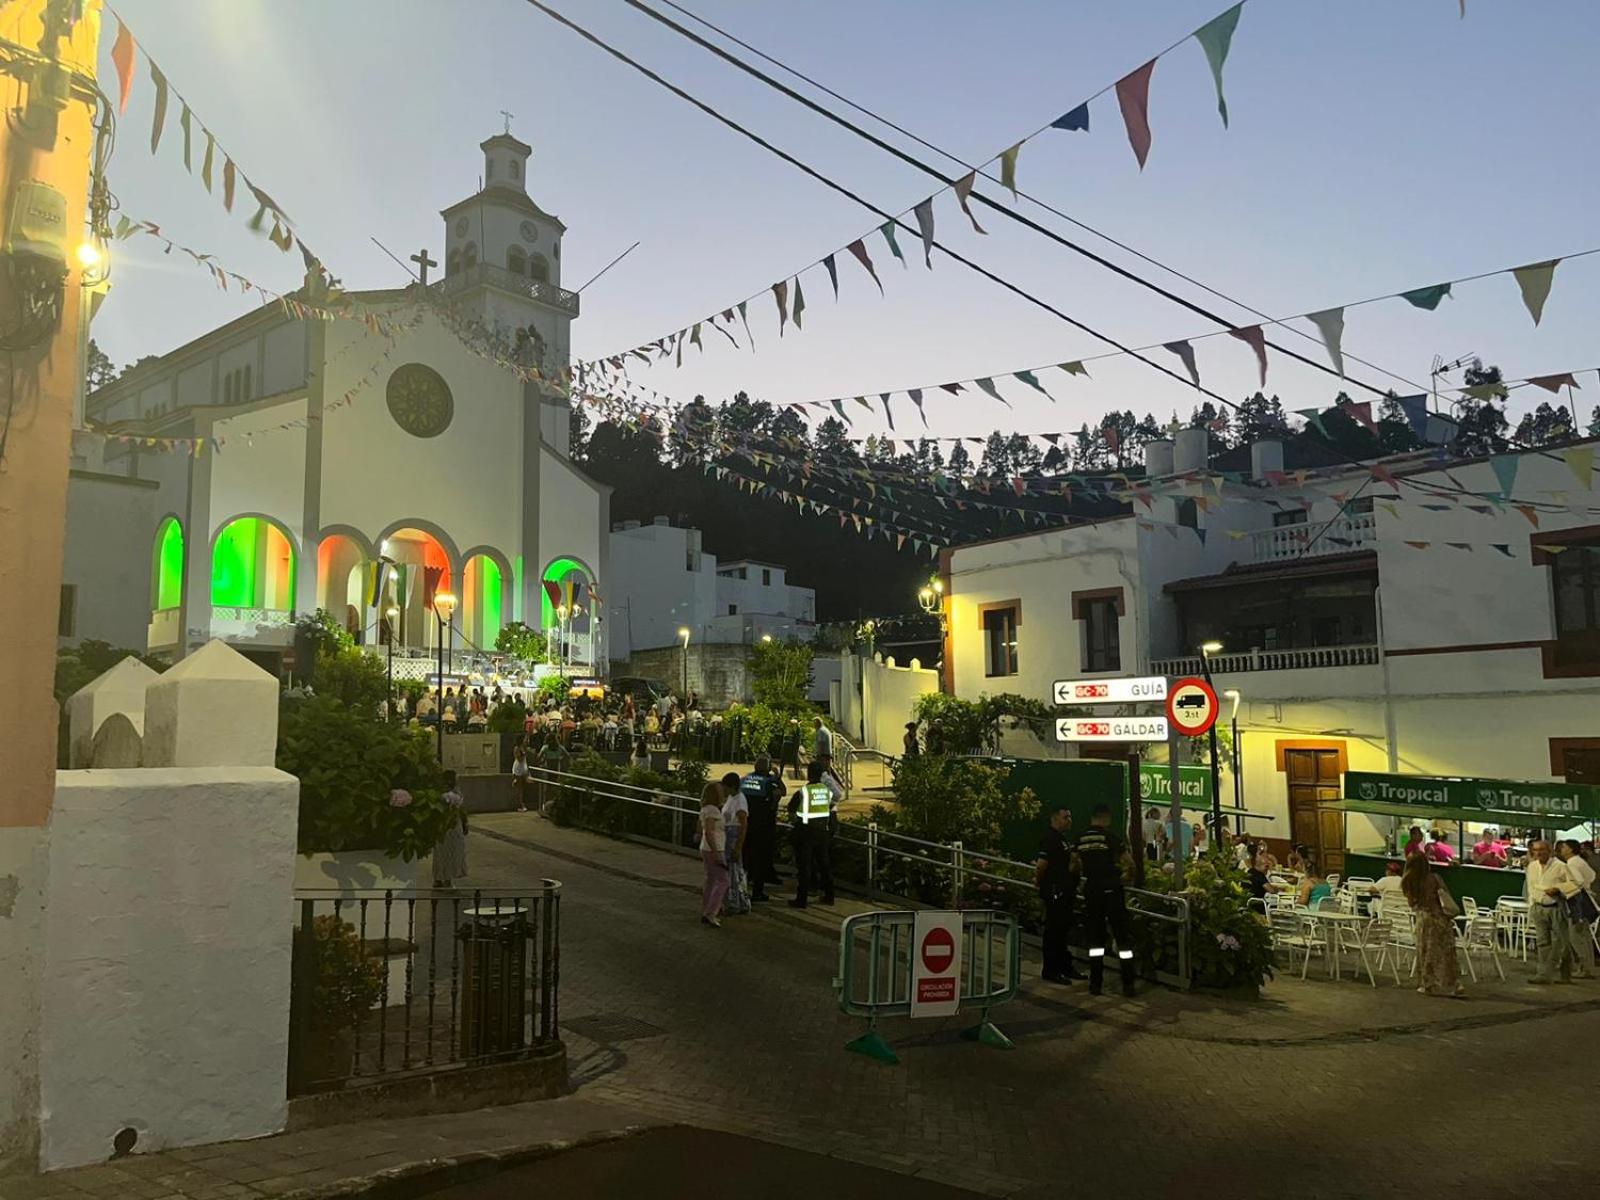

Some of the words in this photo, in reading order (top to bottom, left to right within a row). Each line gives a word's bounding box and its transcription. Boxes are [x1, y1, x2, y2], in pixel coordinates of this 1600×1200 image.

[1076, 685, 1107, 697] GC-70
[1131, 681, 1164, 696] GUÍA
[1077, 723, 1109, 735] GC-70
[1379, 782, 1449, 803] Tropical
[1500, 790, 1579, 811] Tropical
